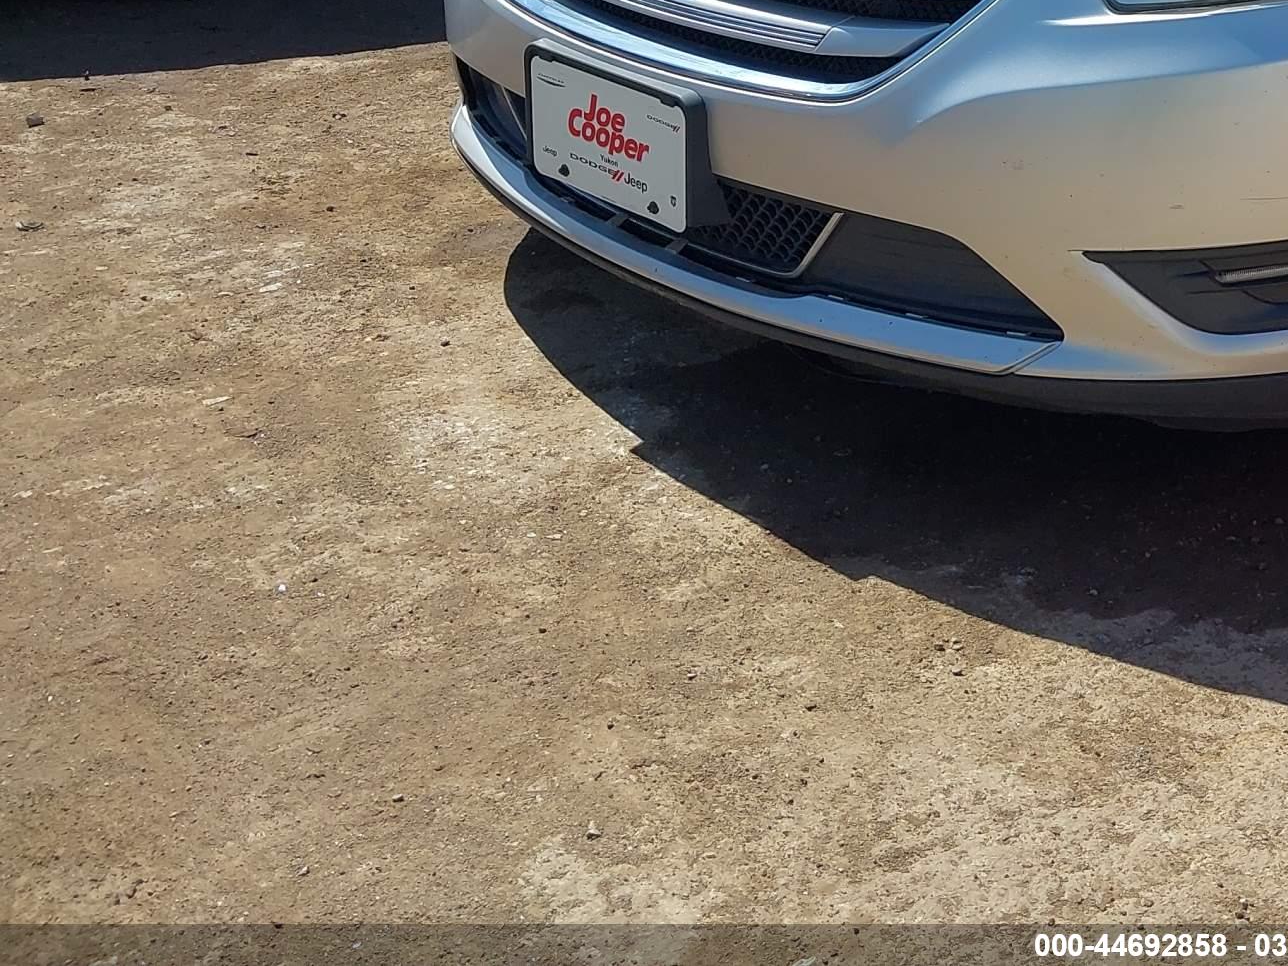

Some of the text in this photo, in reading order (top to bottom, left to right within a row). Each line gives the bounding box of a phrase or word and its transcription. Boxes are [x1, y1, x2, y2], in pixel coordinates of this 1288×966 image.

[583, 92, 626, 134] Joe
[542, 144, 558, 158] Jeep
[567, 107, 651, 163] Cooper
[569, 152, 648, 194] DODGE Jeep
[599, 153, 619, 168] Yukon
